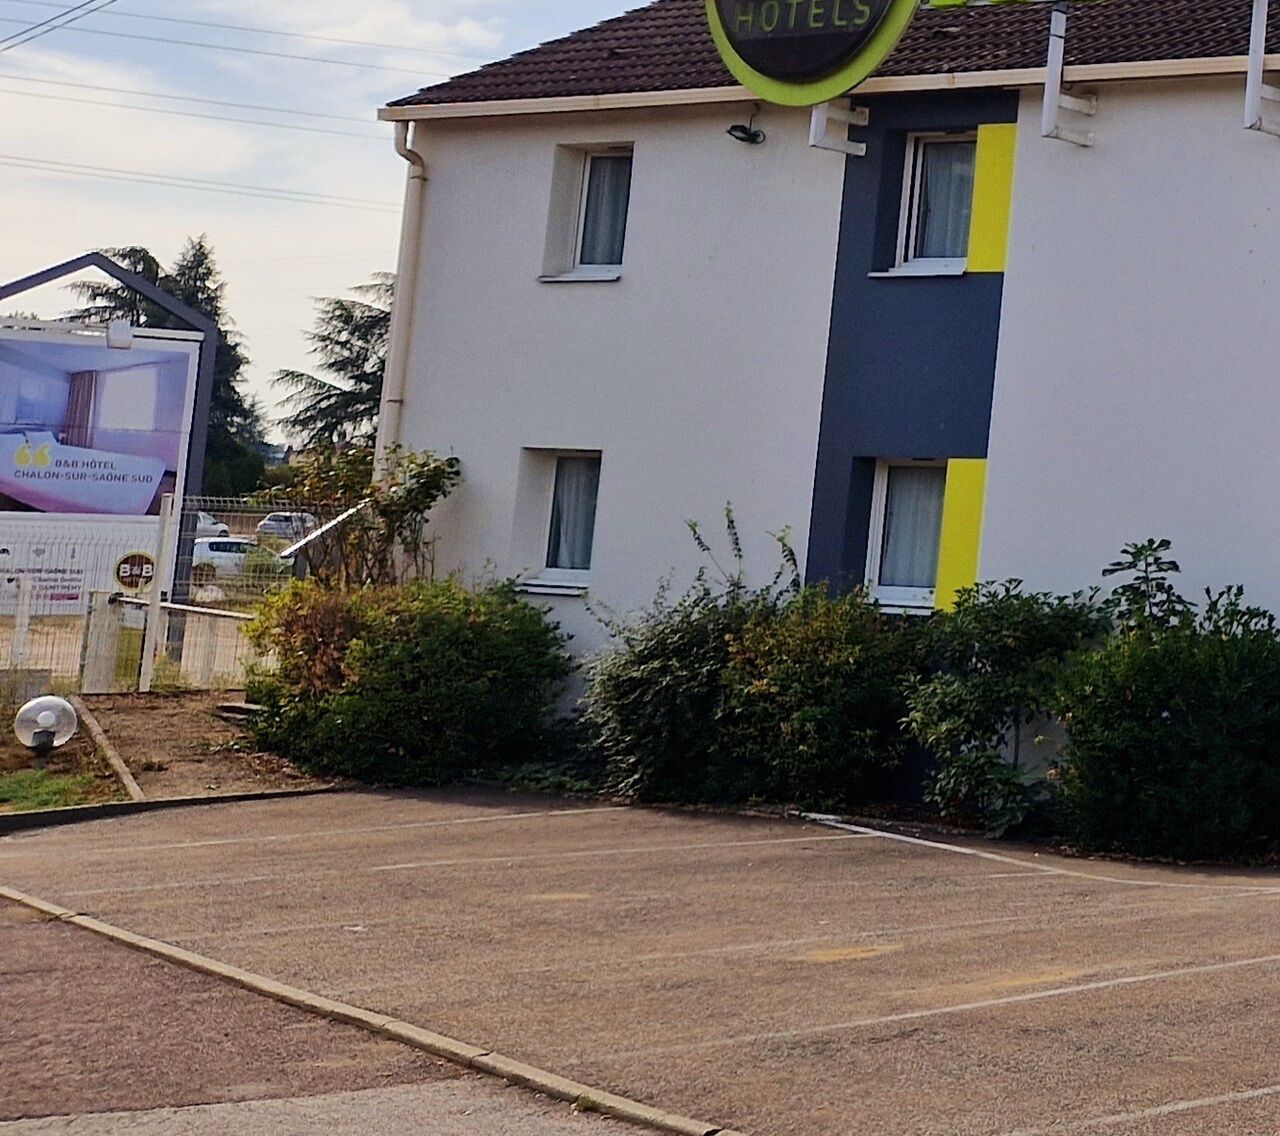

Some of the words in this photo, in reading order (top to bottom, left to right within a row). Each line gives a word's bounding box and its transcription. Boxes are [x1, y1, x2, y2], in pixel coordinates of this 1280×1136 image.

[55, 458, 79, 468] B&B
[82, 456, 117, 470] HÔTEL
[14, 469, 129, 483] CHALON-SUR-SAÔNE
[131, 473, 153, 483] SUD
[119, 563, 153, 577] B&B
